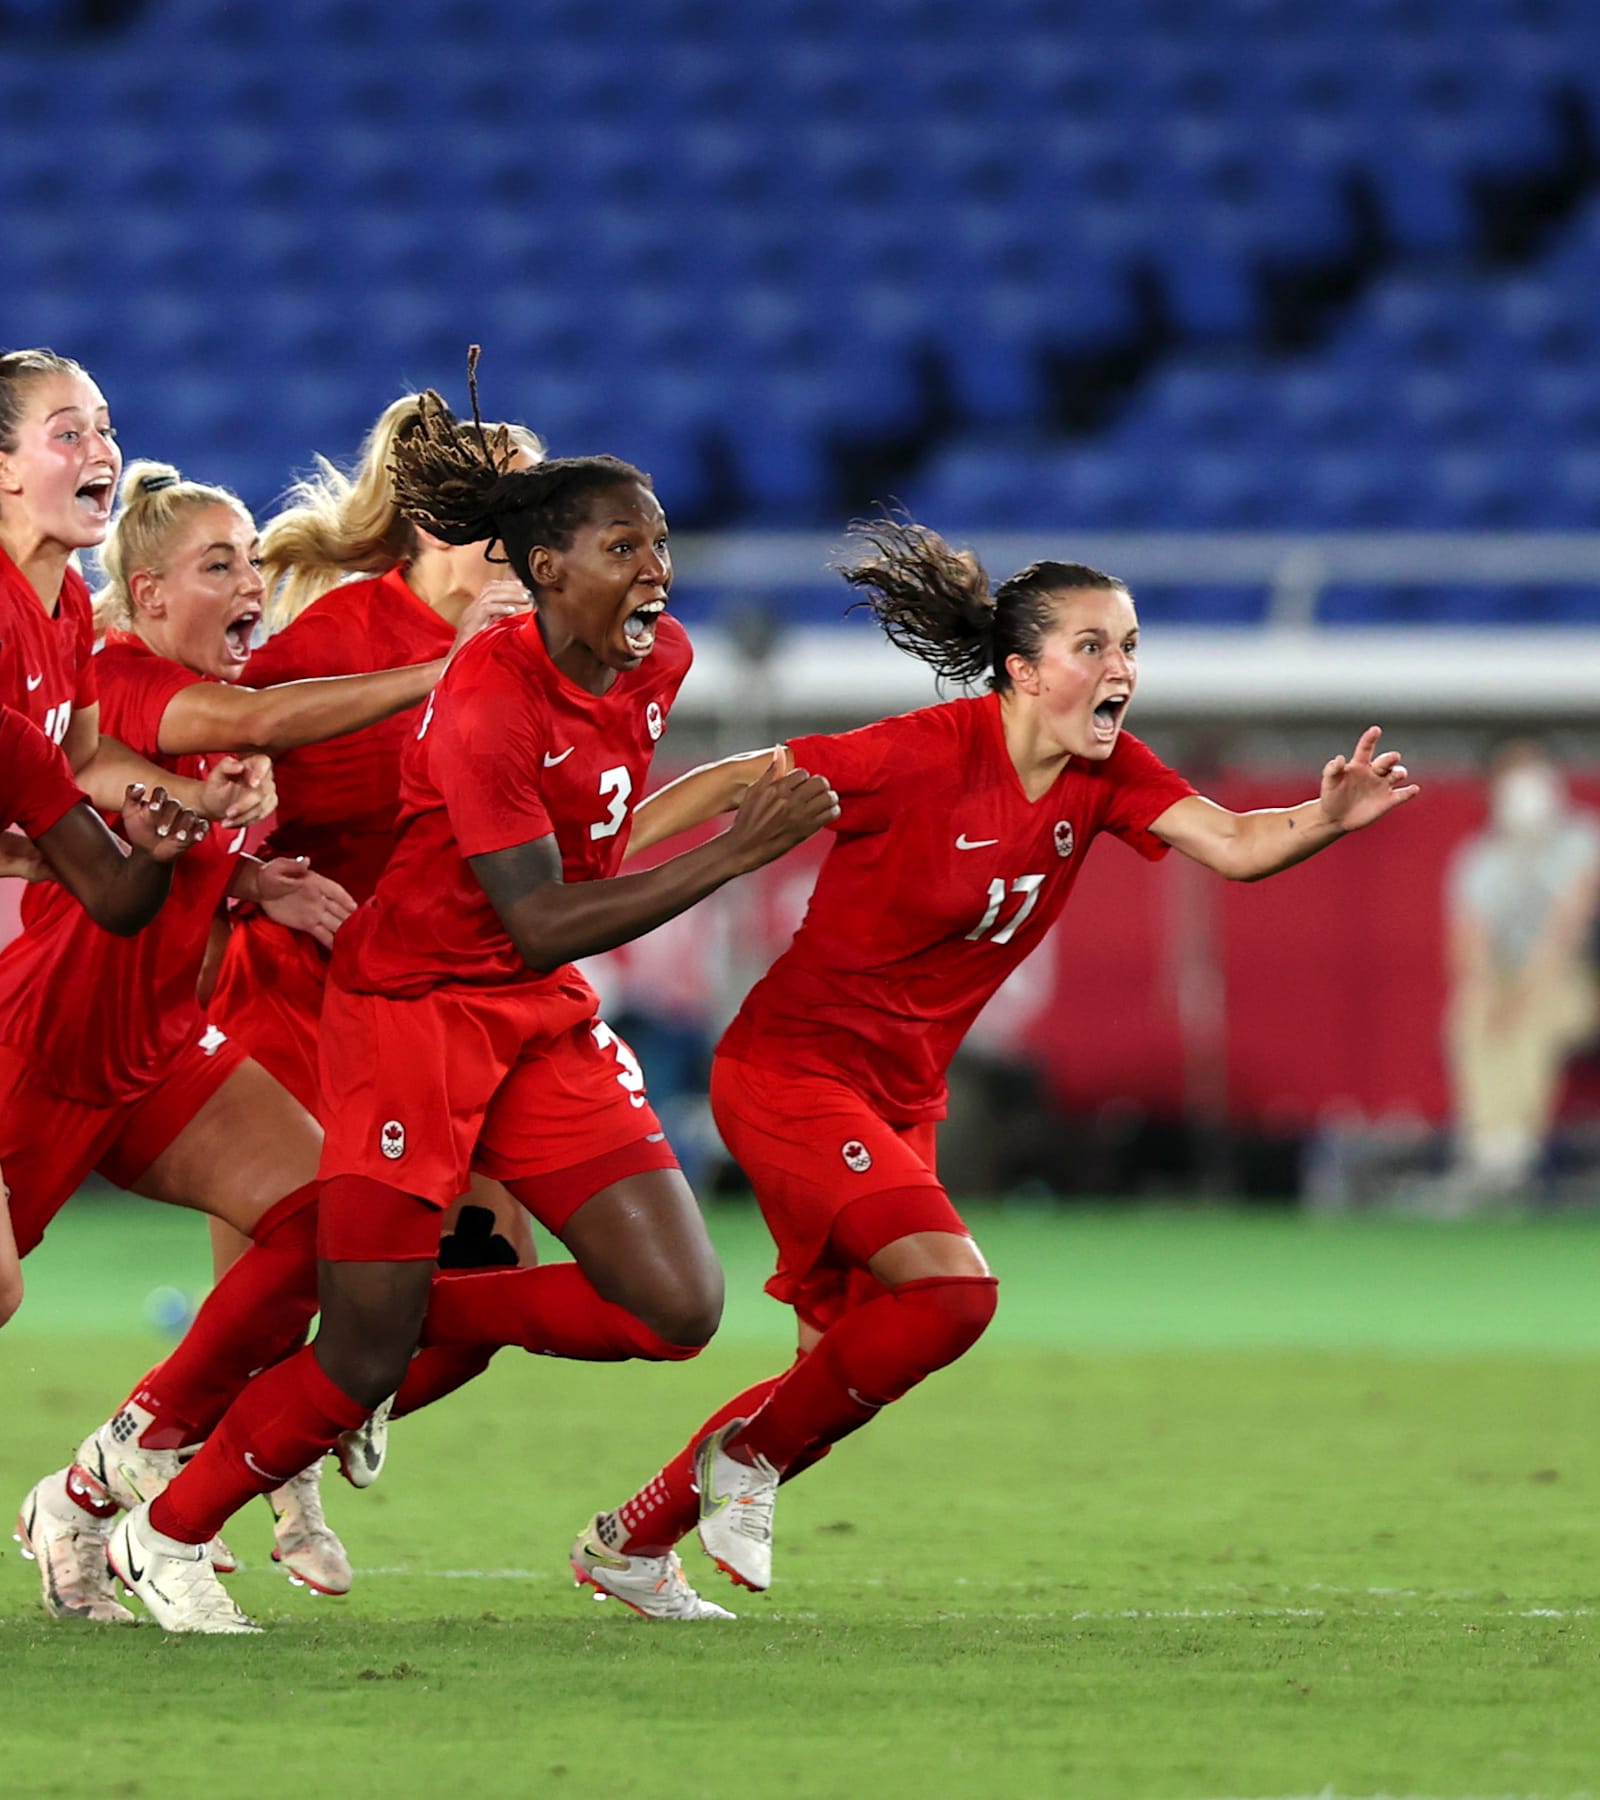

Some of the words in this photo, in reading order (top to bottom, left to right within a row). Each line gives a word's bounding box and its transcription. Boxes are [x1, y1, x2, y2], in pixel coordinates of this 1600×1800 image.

[590, 765, 632, 840] 3
[964, 873, 1046, 945] 17
[591, 1020, 644, 1092] 3
